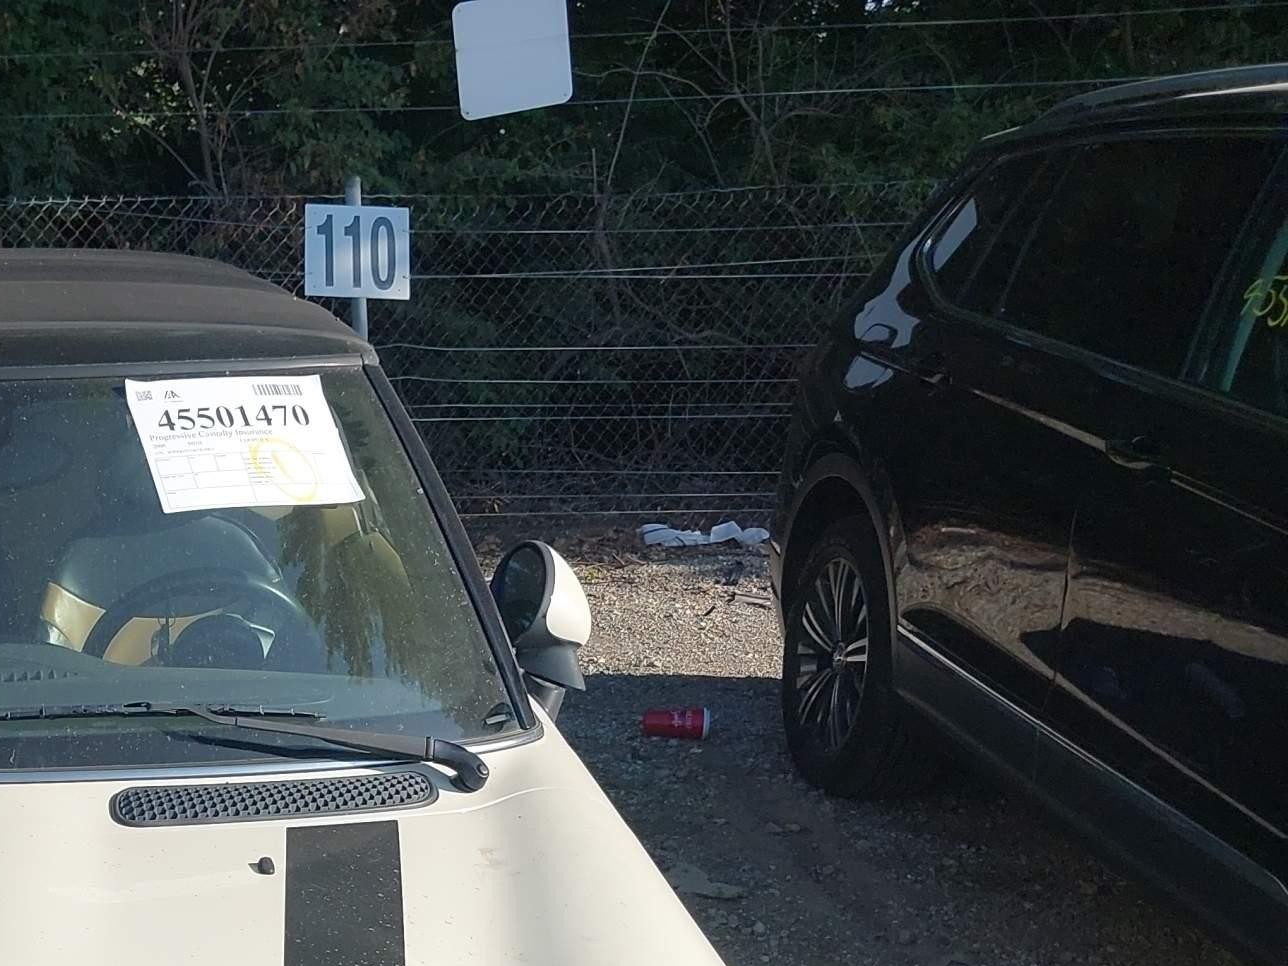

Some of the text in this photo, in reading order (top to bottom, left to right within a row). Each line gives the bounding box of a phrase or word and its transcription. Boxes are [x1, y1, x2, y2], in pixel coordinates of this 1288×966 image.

[316, 214, 396, 290] 110
[158, 403, 310, 432] 45501470
[149, 427, 273, 442] Progressive Casualty Insurance
